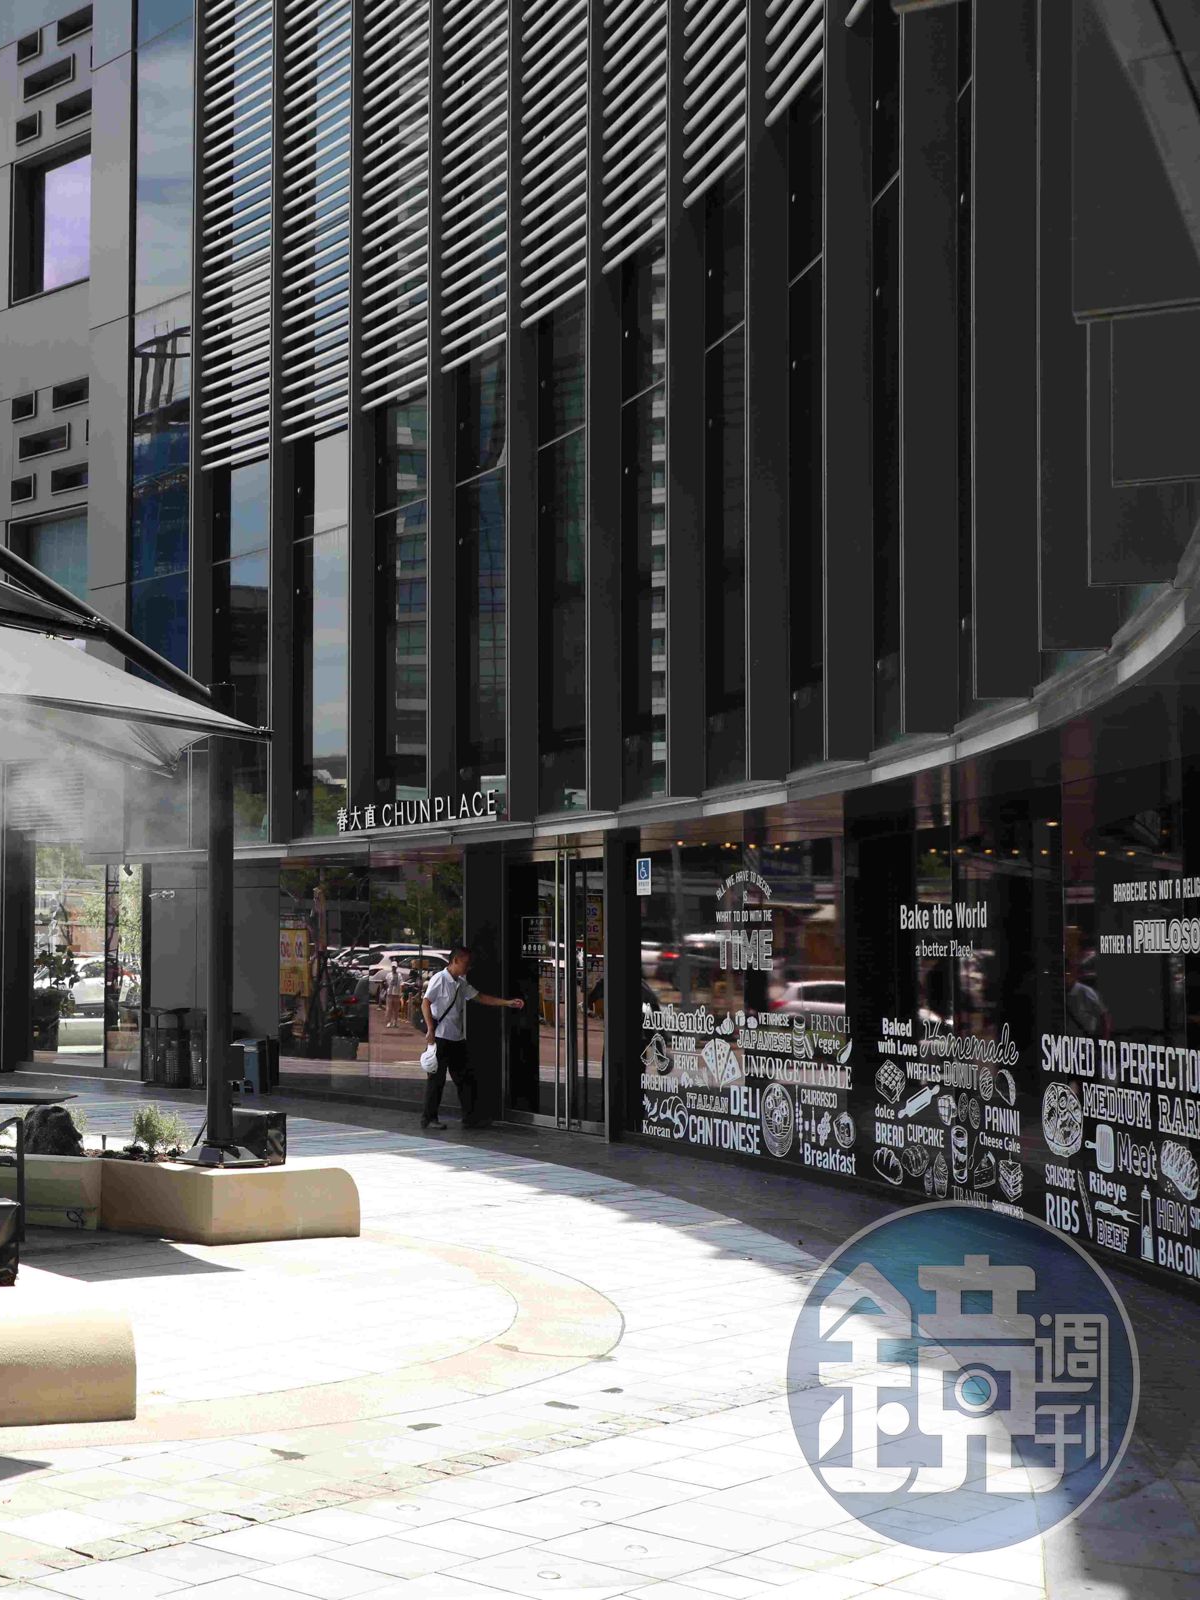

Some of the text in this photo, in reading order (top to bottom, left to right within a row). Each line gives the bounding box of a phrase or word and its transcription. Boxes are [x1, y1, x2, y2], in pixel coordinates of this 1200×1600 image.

[336, 804, 376, 831] 春大直
[715, 870, 773, 901] ALL WE HAVE TO DECIDE
[1113, 881, 1148, 903] BARBECUE
[1149, 880, 1157, 901] IS
[1159, 879, 1173, 900] NOT
[1175, 878, 1181, 899] A
[715, 909, 773, 922] WHAT TO DO WITH THE
[900, 901, 987, 930] Bake the World
[715, 929, 773, 970] TIME
[915, 939, 973, 958] a better Place!
[1100, 934, 1125, 954] RATHER
[1126, 934, 1132, 954] A
[641, 1002, 715, 1035] Authentic
[758, 1011, 790, 1027] VIETNAMESE
[810, 1013, 851, 1034] FRENCH
[882, 1017, 912, 1037] Baked
[671, 1035, 696, 1052] FLAVOR
[736, 1029, 793, 1054] JAPANESE
[812, 1033, 841, 1055] Veggie
[877, 1036, 918, 1057] with Love
[920, 1019, 1019, 1066] Homemade
[673, 1053, 699, 1071] HEAVEN
[1041, 1033, 1095, 1077] SMOKED
[1098, 1039, 1117, 1081] TO
[640, 1073, 679, 1094] ARGENTINA
[741, 1054, 853, 1091] UNFORGETTABLE
[906, 1061, 941, 1083] WAFFLES
[943, 1061, 979, 1091] DONUT
[686, 1092, 729, 1114] ITALIAN
[730, 1085, 760, 1119] DELI
[800, 1088, 838, 1109] CHURRASCO
[1083, 1082, 1152, 1130] MEDIUM
[874, 1104, 895, 1120] dolce
[984, 1105, 1020, 1137] PANINI
[642, 1119, 671, 1138] Korean
[688, 1114, 761, 1155] CANTONESE
[875, 1122, 905, 1148] BREAD
[907, 1123, 945, 1148] CUPCAKE
[979, 1131, 1021, 1153] Cheese Cake
[804, 1142, 856, 1176] Breakfast
[1117, 1131, 1158, 1181] Meat
[1045, 1163, 1076, 1191] SAUSAGE
[1089, 1171, 1127, 1205] Ribeye
[952, 1185, 988, 1210] TIRAMISU
[1045, 1192, 1080, 1234] RIBS
[1156, 1197, 1188, 1237] HAM
[1096, 1218, 1129, 1254] BEEF
[1158, 1236, 1200, 1279] BACON
